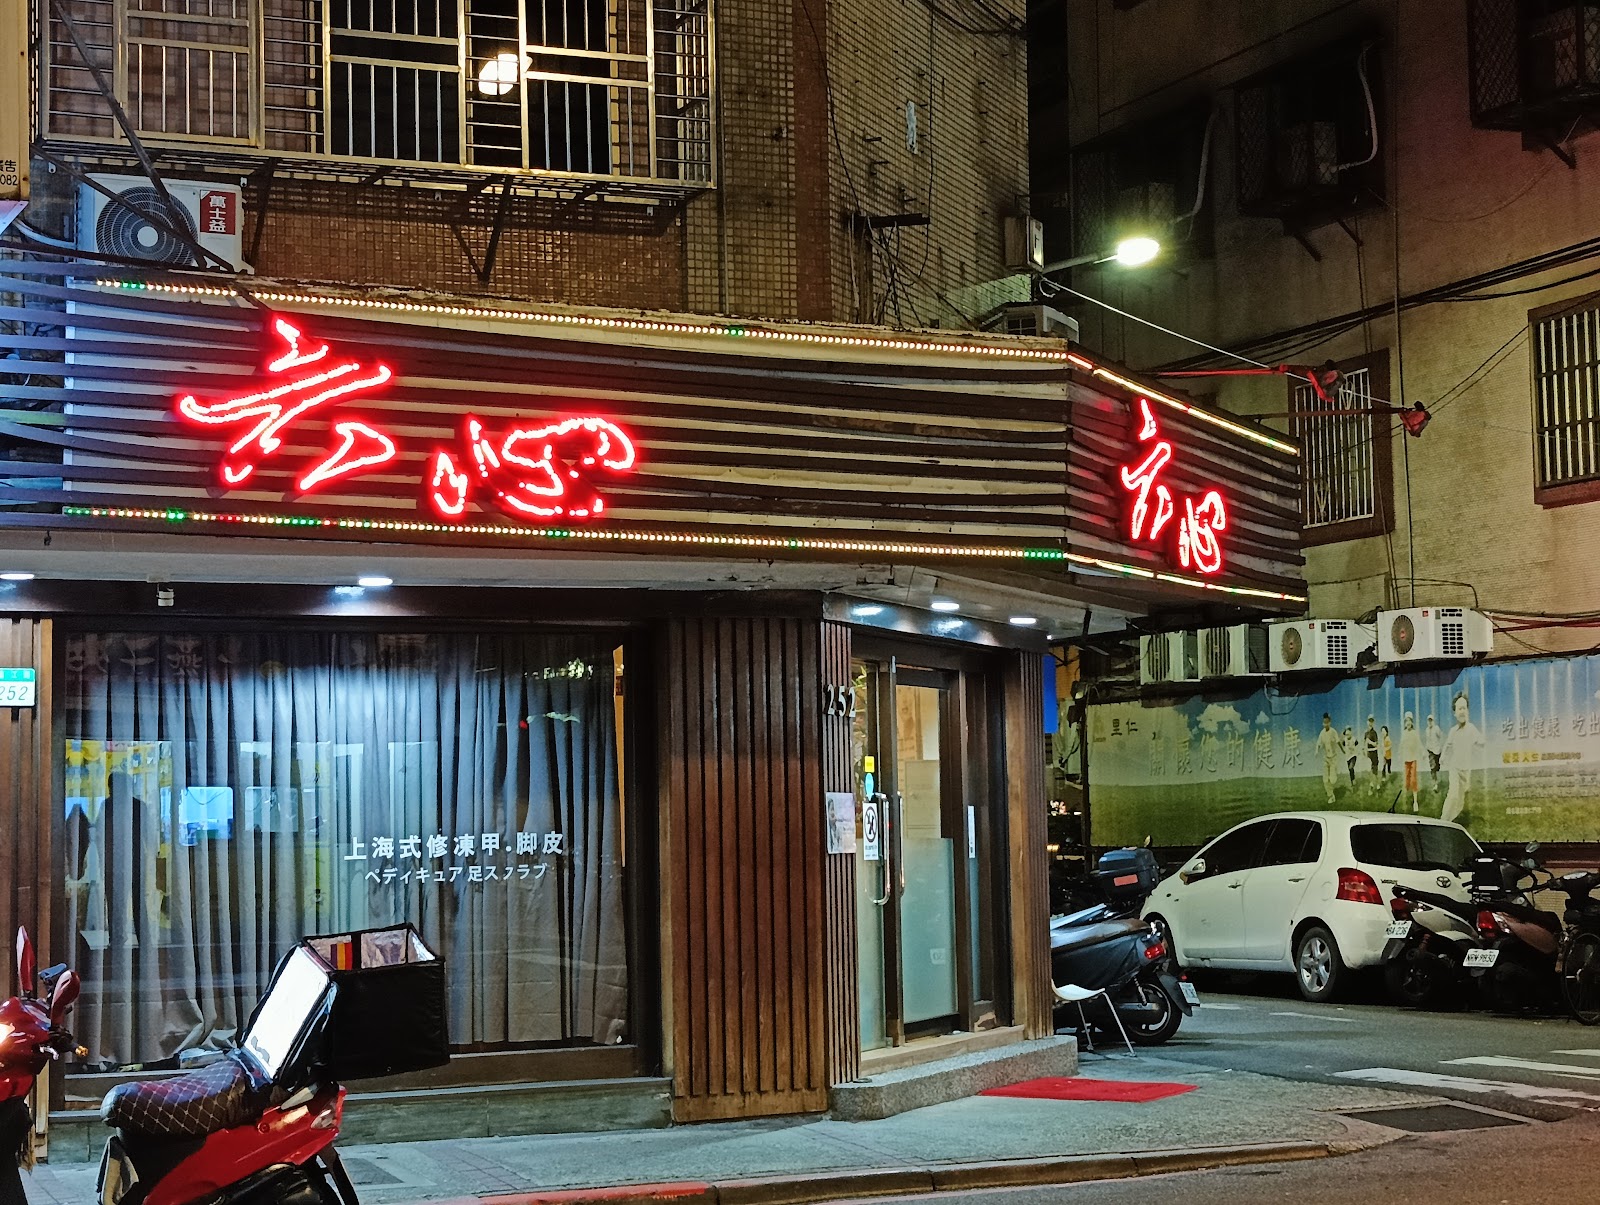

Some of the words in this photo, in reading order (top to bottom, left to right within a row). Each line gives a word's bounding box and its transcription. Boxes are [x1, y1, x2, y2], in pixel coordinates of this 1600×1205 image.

[208, 195, 227, 233] 萬士益
[827, 683, 856, 718] 252
[1110, 718, 1139, 736] 里仁
[1149, 726, 1304, 777] 關懷您的健康
